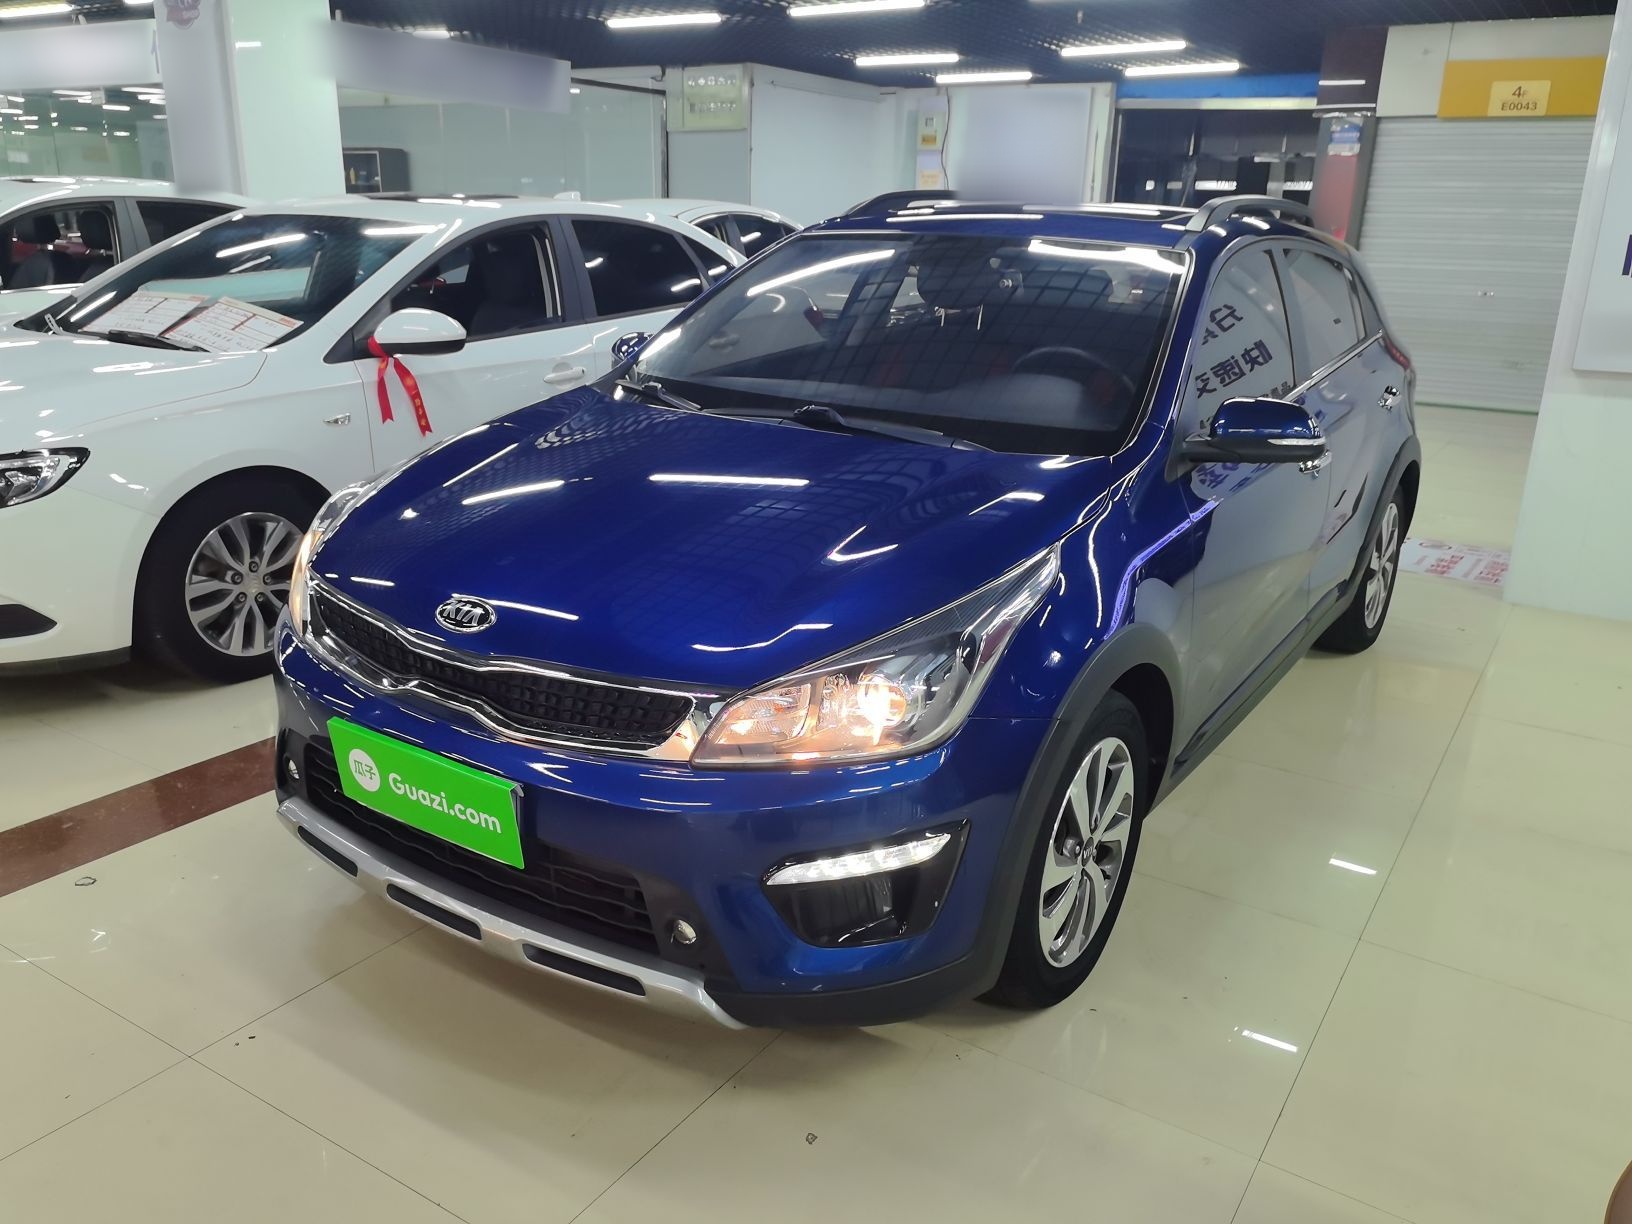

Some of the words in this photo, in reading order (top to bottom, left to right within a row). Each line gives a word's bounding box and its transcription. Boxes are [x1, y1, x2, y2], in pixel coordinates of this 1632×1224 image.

[1500, 101, 1538, 112] E0043
[440, 600, 486, 627] KIA
[353, 758, 377, 781] 瓜子
[388, 771, 503, 834] Guazi.com
